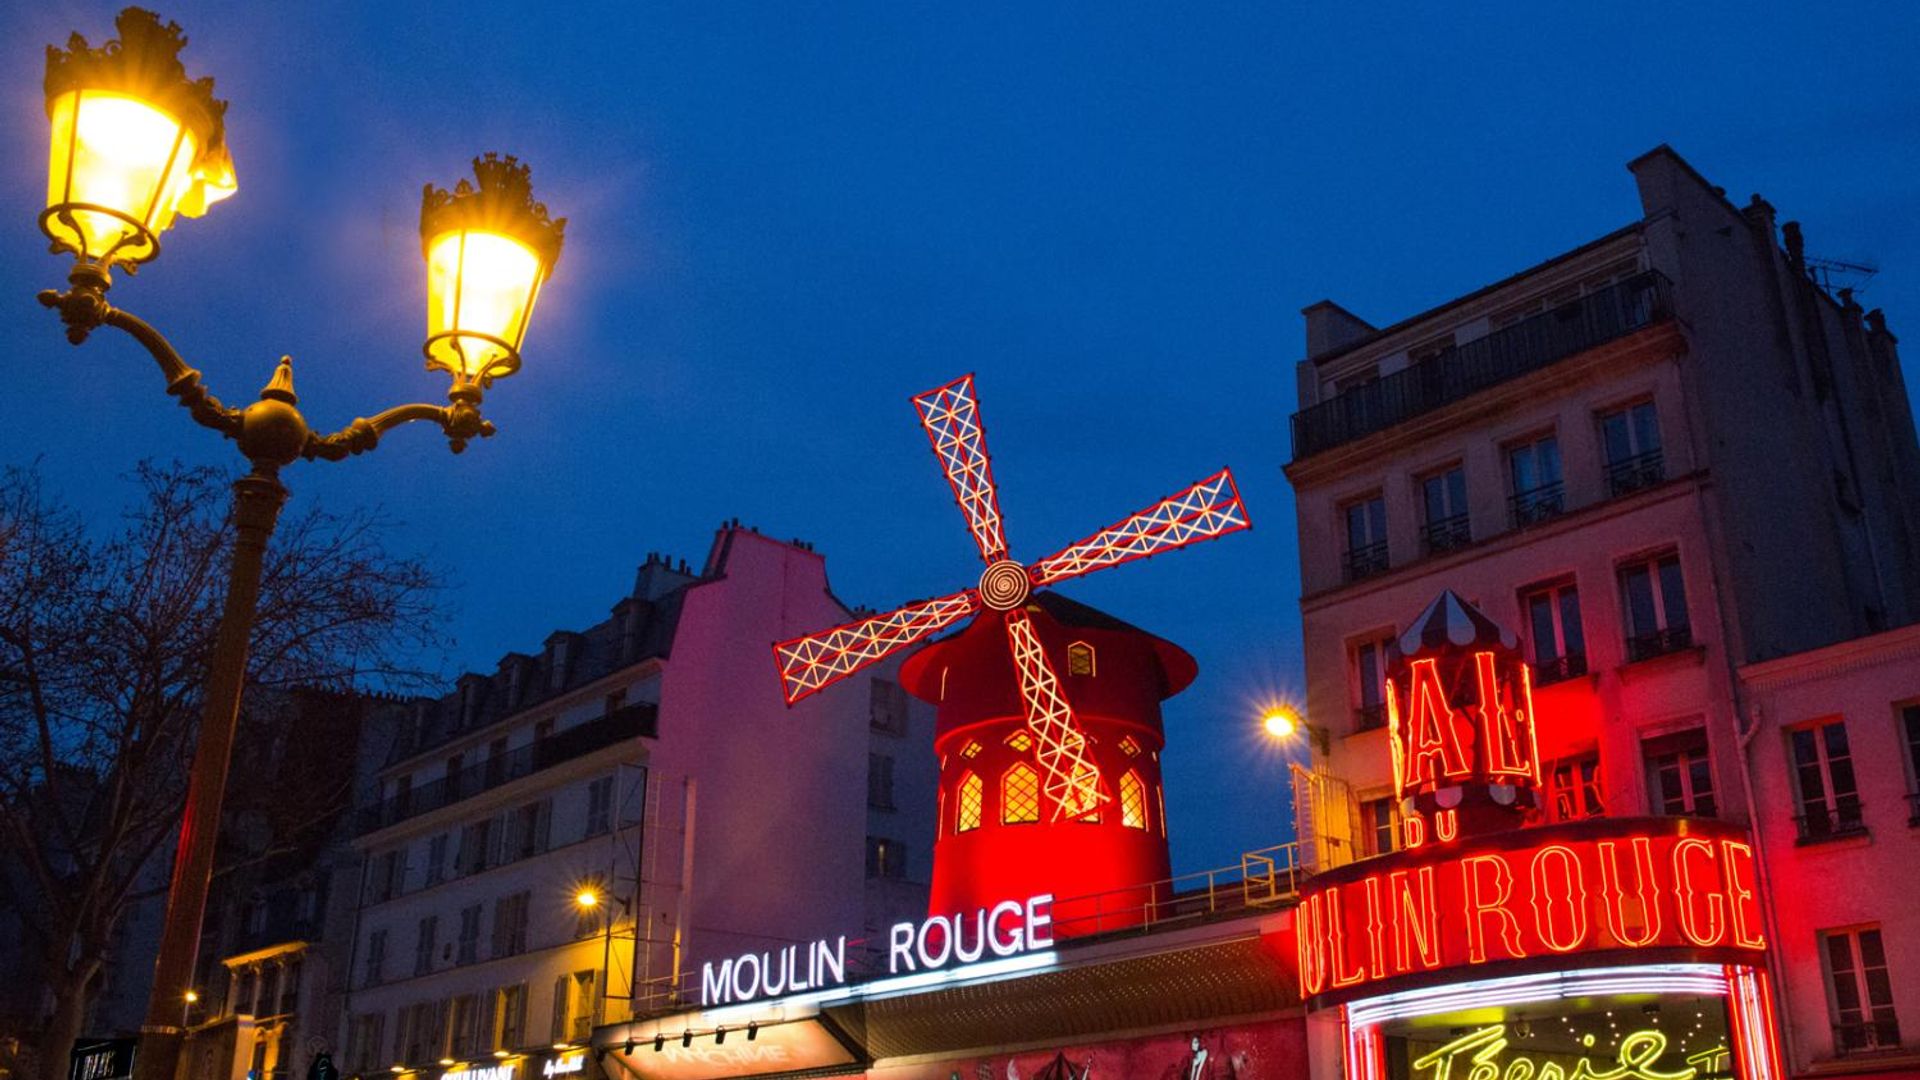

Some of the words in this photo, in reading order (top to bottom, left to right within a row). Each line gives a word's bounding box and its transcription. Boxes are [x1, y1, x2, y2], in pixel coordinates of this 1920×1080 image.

[1403, 809, 1457, 848] DU
[701, 935, 846, 1006] MOULIN
[889, 893, 1055, 974] ROUGE
[1461, 837, 1767, 964] ROUGE
